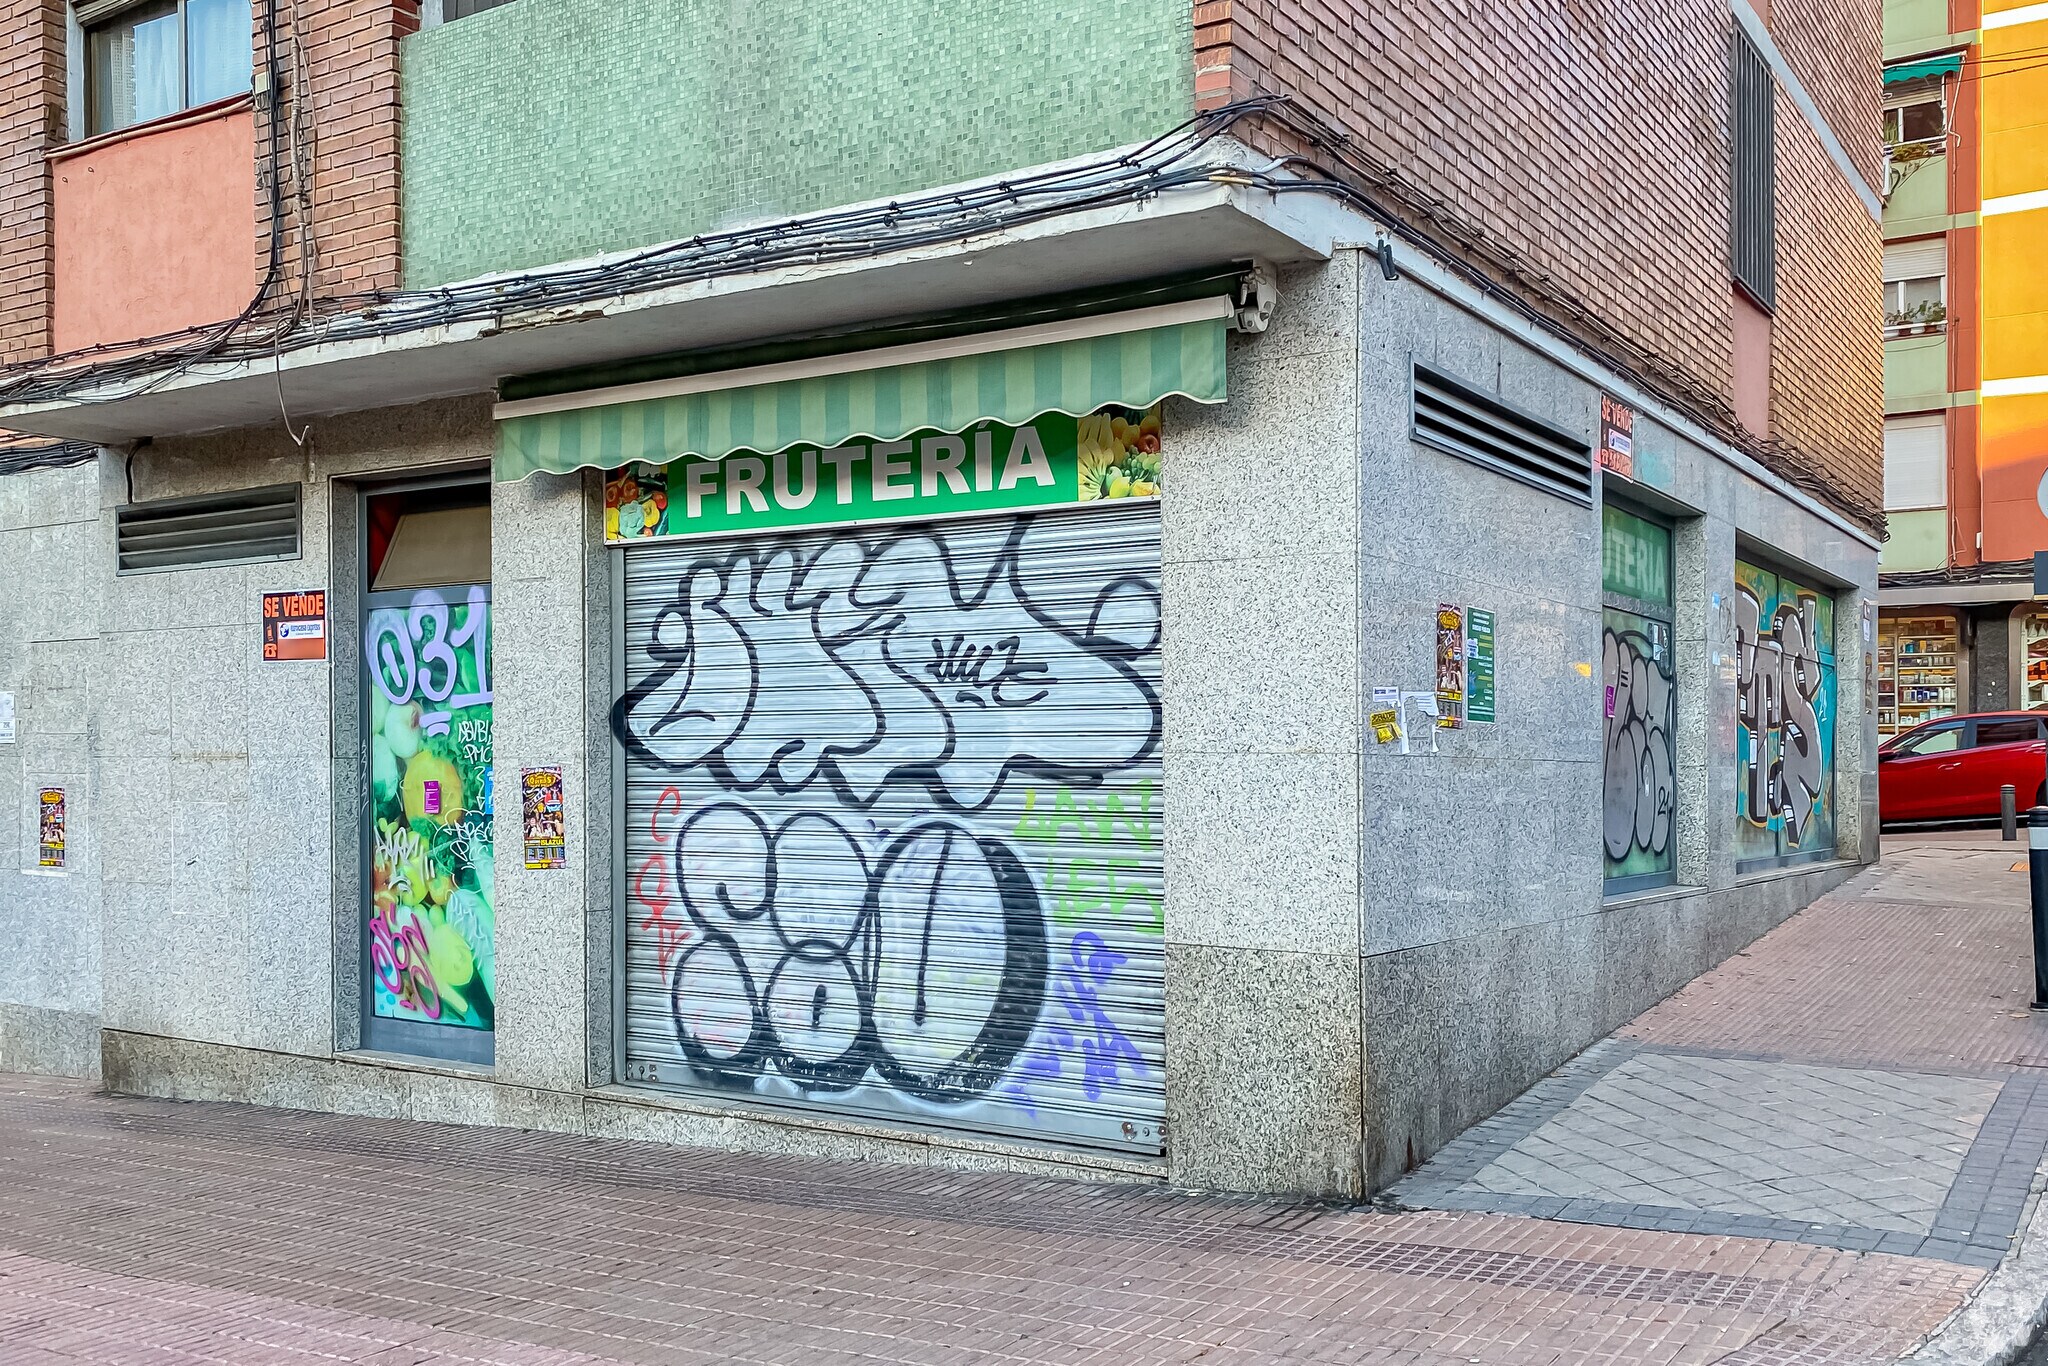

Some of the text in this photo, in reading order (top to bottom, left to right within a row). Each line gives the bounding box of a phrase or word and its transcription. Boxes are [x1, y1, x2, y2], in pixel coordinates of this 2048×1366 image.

[686, 421, 1056, 518] FRUTERÍA
[264, 595, 324, 618] SE VENDE
